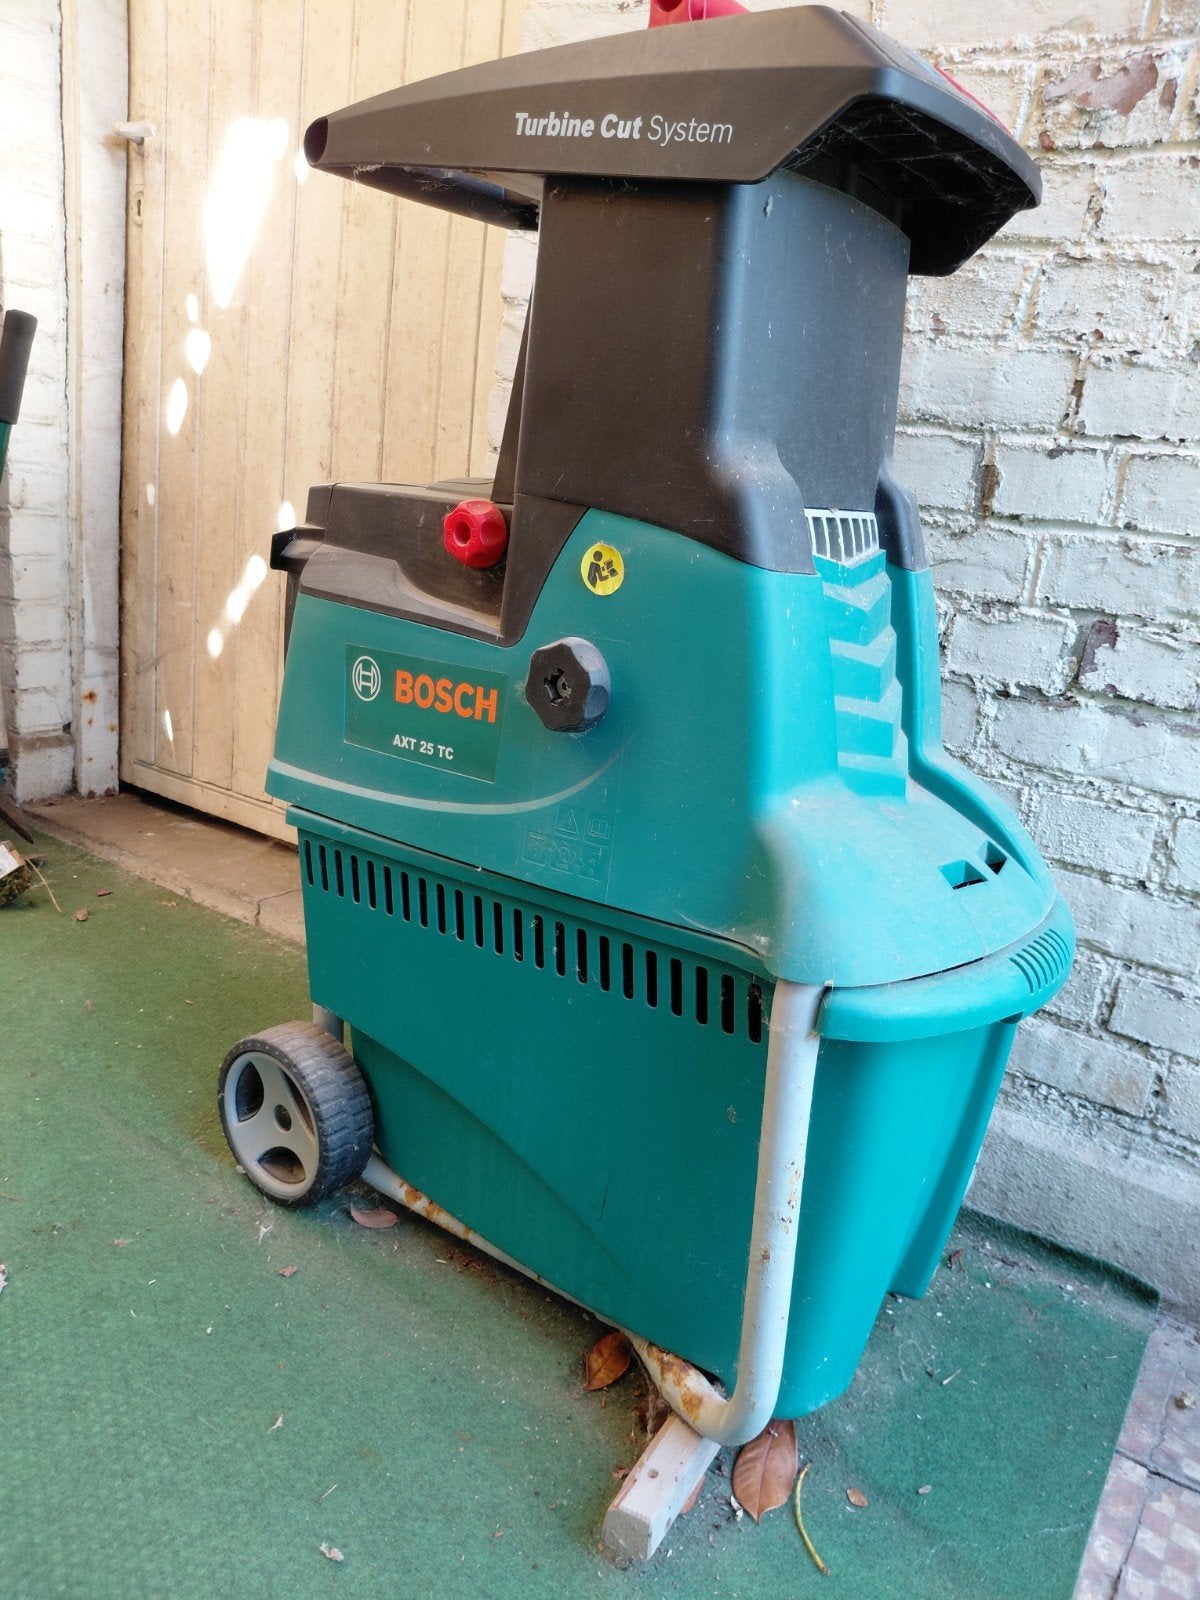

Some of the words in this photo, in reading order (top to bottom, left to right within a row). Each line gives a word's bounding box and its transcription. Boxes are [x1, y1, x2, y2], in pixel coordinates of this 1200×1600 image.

[515, 111, 595, 138] Turbine
[600, 113, 642, 139] Cut
[648, 115, 733, 146] System
[395, 668, 498, 723] BOSCH
[393, 734, 417, 751] AXT
[419, 740, 434, 755] 25
[437, 745, 454, 760] TC
